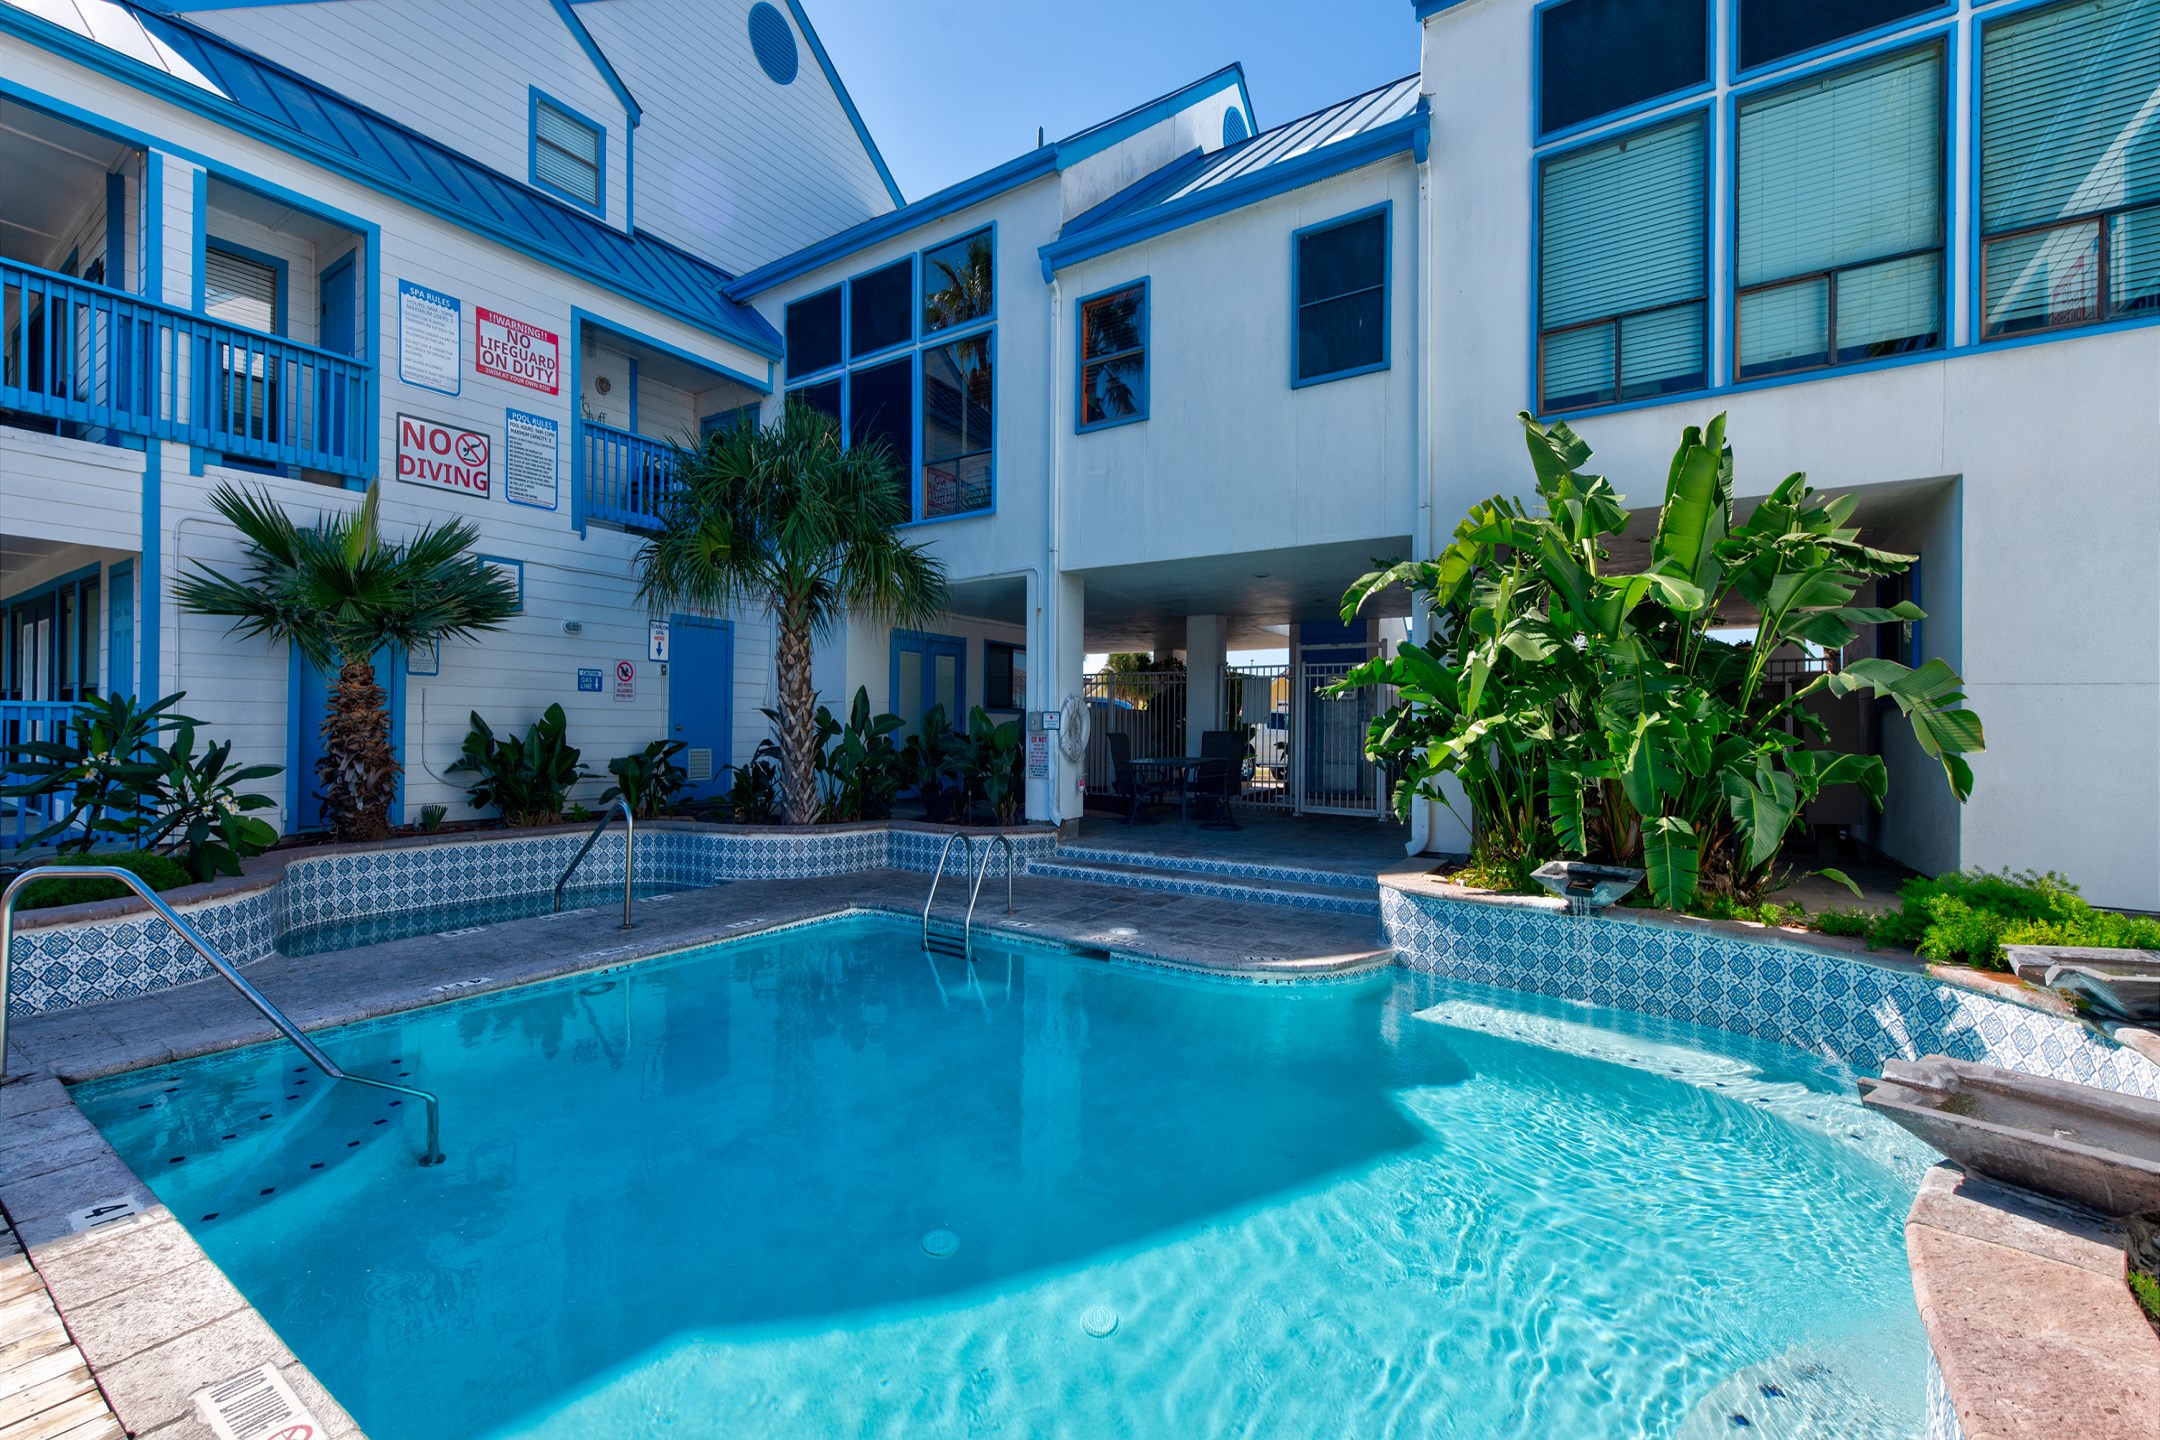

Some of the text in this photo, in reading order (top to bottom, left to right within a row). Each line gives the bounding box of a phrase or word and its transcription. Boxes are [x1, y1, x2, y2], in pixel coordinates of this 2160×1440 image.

[410, 287, 450, 307] SPA RULES
[407, 303, 432, 317] MAXIMUM
[434, 313, 449, 323] USERS:
[489, 313, 548, 340] !!WARNING!!
[507, 330, 530, 349] NO
[480, 335, 555, 370] LIFEGUARD
[482, 350, 553, 384] ON DUTY
[486, 368, 501, 376] SWIM
[510, 375, 524, 384] YOUR
[525, 380, 538, 388] OWN
[539, 383, 551, 392] RISK
[512, 412, 552, 429] POOL RULES
[403, 420, 451, 455] NO
[511, 428, 529, 438] MAXIMUM
[530, 433, 548, 442] CAPACITY:
[399, 454, 487, 491] DIVING
